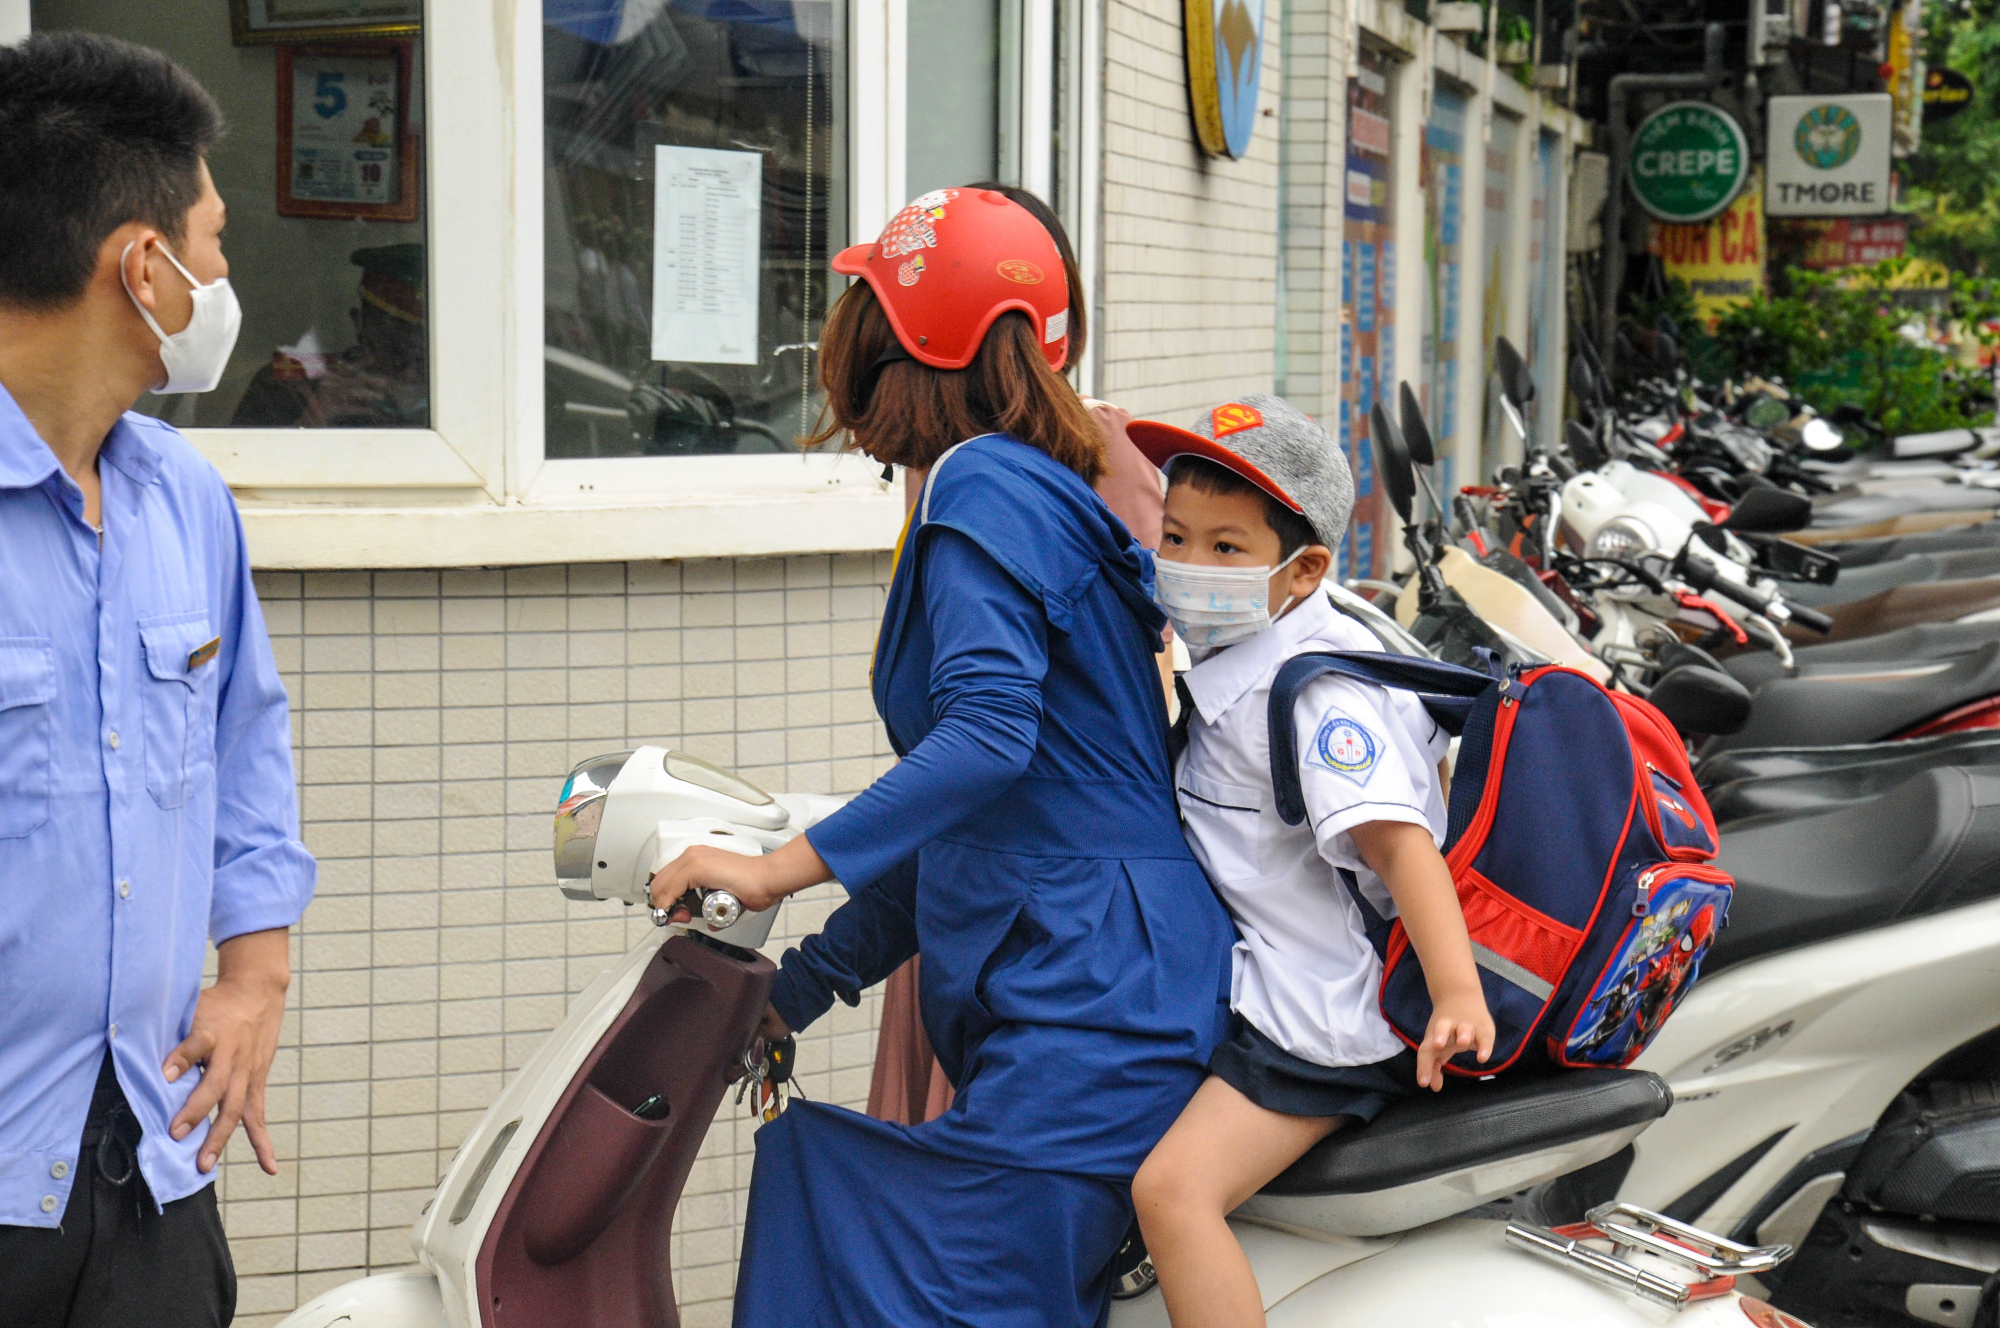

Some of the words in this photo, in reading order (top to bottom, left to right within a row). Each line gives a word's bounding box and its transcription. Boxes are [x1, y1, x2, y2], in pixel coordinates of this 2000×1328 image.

[314, 72, 348, 120] 5
[1637, 147, 1735, 177] CREPE
[1777, 181, 1876, 204] TMORE
